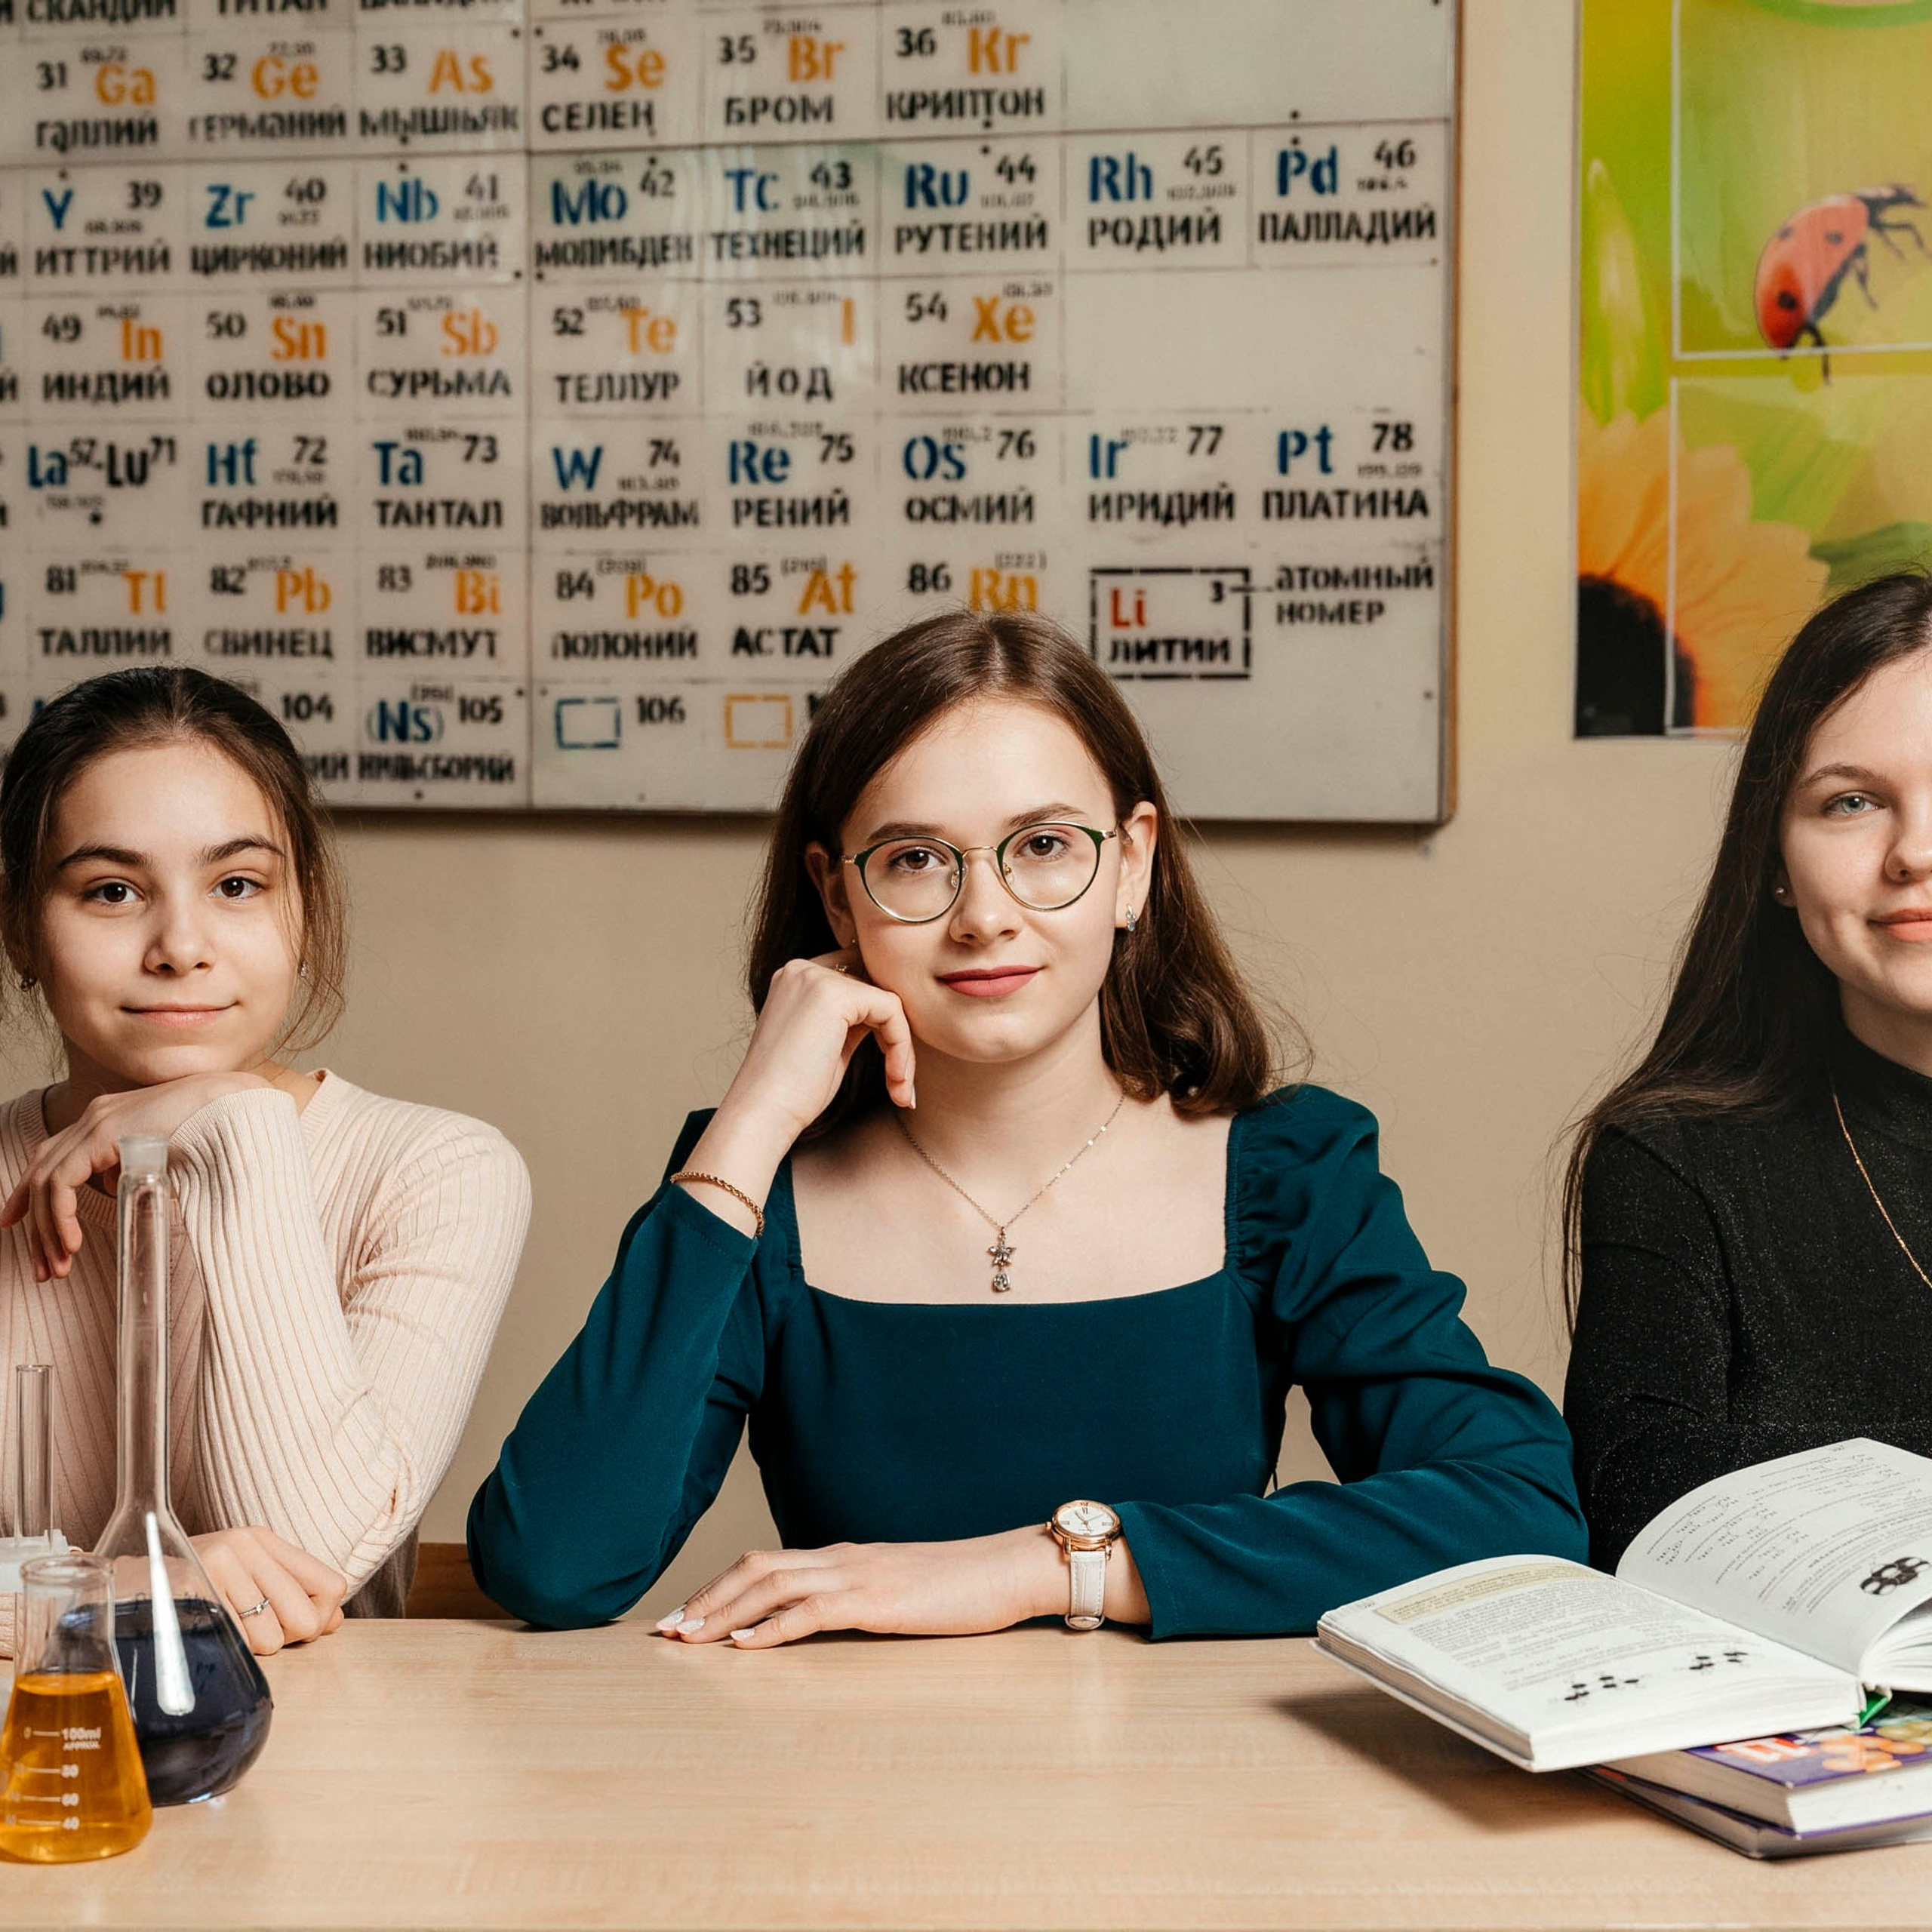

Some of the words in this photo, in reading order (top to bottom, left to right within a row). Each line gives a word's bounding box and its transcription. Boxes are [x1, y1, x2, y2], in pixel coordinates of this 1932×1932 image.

[371, 45, 408, 73] 33
[428, 48, 495, 94] As
[542, 44, 580, 72] 34
[604, 43, 666, 91] Se
[719, 35, 756, 65] 35
[789, 34, 845, 82] Br
[896, 27, 937, 57] 36
[968, 27, 1030, 75] Kr
[38, 62, 67, 90] 31
[96, 63, 156, 106] Ga
[204, 54, 236, 81] 32
[251, 56, 318, 100] Ge
[541, 101, 655, 133] СЕЛЕН
[725, 94, 833, 126] БРОМ
[886, 88, 1044, 120] КРИПТОН
[810, 160, 853, 190] 43
[905, 162, 969, 209] Ru
[996, 154, 1037, 184] 44
[1089, 152, 1152, 202] Rh
[1183, 146, 1224, 177] 45
[1276, 144, 1338, 197] Pd
[1373, 139, 1417, 170] 46
[42, 188, 73, 229] Y
[128, 180, 162, 209] 39
[206, 184, 254, 228] Zr
[285, 177, 326, 204] 40
[377, 177, 439, 223] Nb
[465, 173, 499, 202] 41
[552, 178, 627, 225] Mo
[640, 169, 675, 198] 42
[710, 219, 865, 260] ТЕХНЕЦИЙ
[895, 212, 1048, 254] РУТЕНИЙ
[1088, 206, 1222, 251] РОДИЙ
[1258, 202, 1437, 244] ПАЛЛАДИЙ
[35, 238, 171, 274] ИТТРИЙ
[364, 231, 499, 268] НИОБИЙ
[377, 307, 407, 337] 51
[442, 307, 500, 356] Sb
[553, 307, 584, 336] 52
[620, 307, 677, 355] Te
[728, 298, 762, 328] 53
[906, 292, 948, 323] 54
[971, 295, 1035, 343] Xe
[42, 312, 82, 343] 49
[122, 318, 162, 361] In
[206, 310, 246, 339] 50
[271, 315, 326, 361] Sn
[42, 365, 171, 404] ИНДИЙ
[206, 371, 331, 399] ОЛОВО
[368, 370, 511, 398] СУРЬМА
[555, 371, 680, 404] ТЕЛЛУР
[899, 361, 1031, 393] КСЕНОН
[207, 438, 256, 486] Hf
[294, 435, 328, 465] 72
[372, 441, 423, 485] Ta
[463, 434, 499, 464] 73
[728, 440, 790, 485] Re
[820, 433, 855, 463] 75
[997, 429, 1035, 460] 76
[1186, 426, 1224, 456] 77
[1277, 425, 1334, 475] Pt
[1371, 423, 1415, 454] 78
[553, 446, 603, 491] W
[649, 439, 681, 468] 74
[202, 492, 337, 528] ГАФНИЙ
[374, 499, 503, 528] ТАНТАЛ
[733, 488, 851, 528] РЕНИЙ
[906, 485, 1034, 524] ОСМИЙ
[1088, 481, 1235, 527] ИРИДИЙ
[1261, 488, 1429, 521] ПЛАТИНА
[46, 565, 76, 593] 81
[210, 565, 246, 595] 82
[275, 566, 331, 615] Pb
[379, 564, 412, 592] 83
[455, 569, 500, 615] Bi
[555, 570, 594, 601] 84
[625, 571, 684, 620] Po
[731, 563, 771, 595] 85
[797, 562, 857, 615] At
[909, 562, 952, 595] 86
[969, 568, 1038, 614] Rn
[1109, 586, 1148, 629] Li
[1211, 580, 1225, 605] 3
[1275, 601, 1386, 626] НОМЕР
[205, 628, 334, 660] СВИНЕЦ
[366, 628, 498, 659] ВИСМУТ
[551, 624, 698, 660] ПОЛОНИЙ
[731, 623, 840, 657] АСТАТ
[282, 694, 334, 722] 104
[457, 695, 503, 724] 105
[636, 695, 686, 724] 106
[61, 1727, 102, 1740] 100ml
